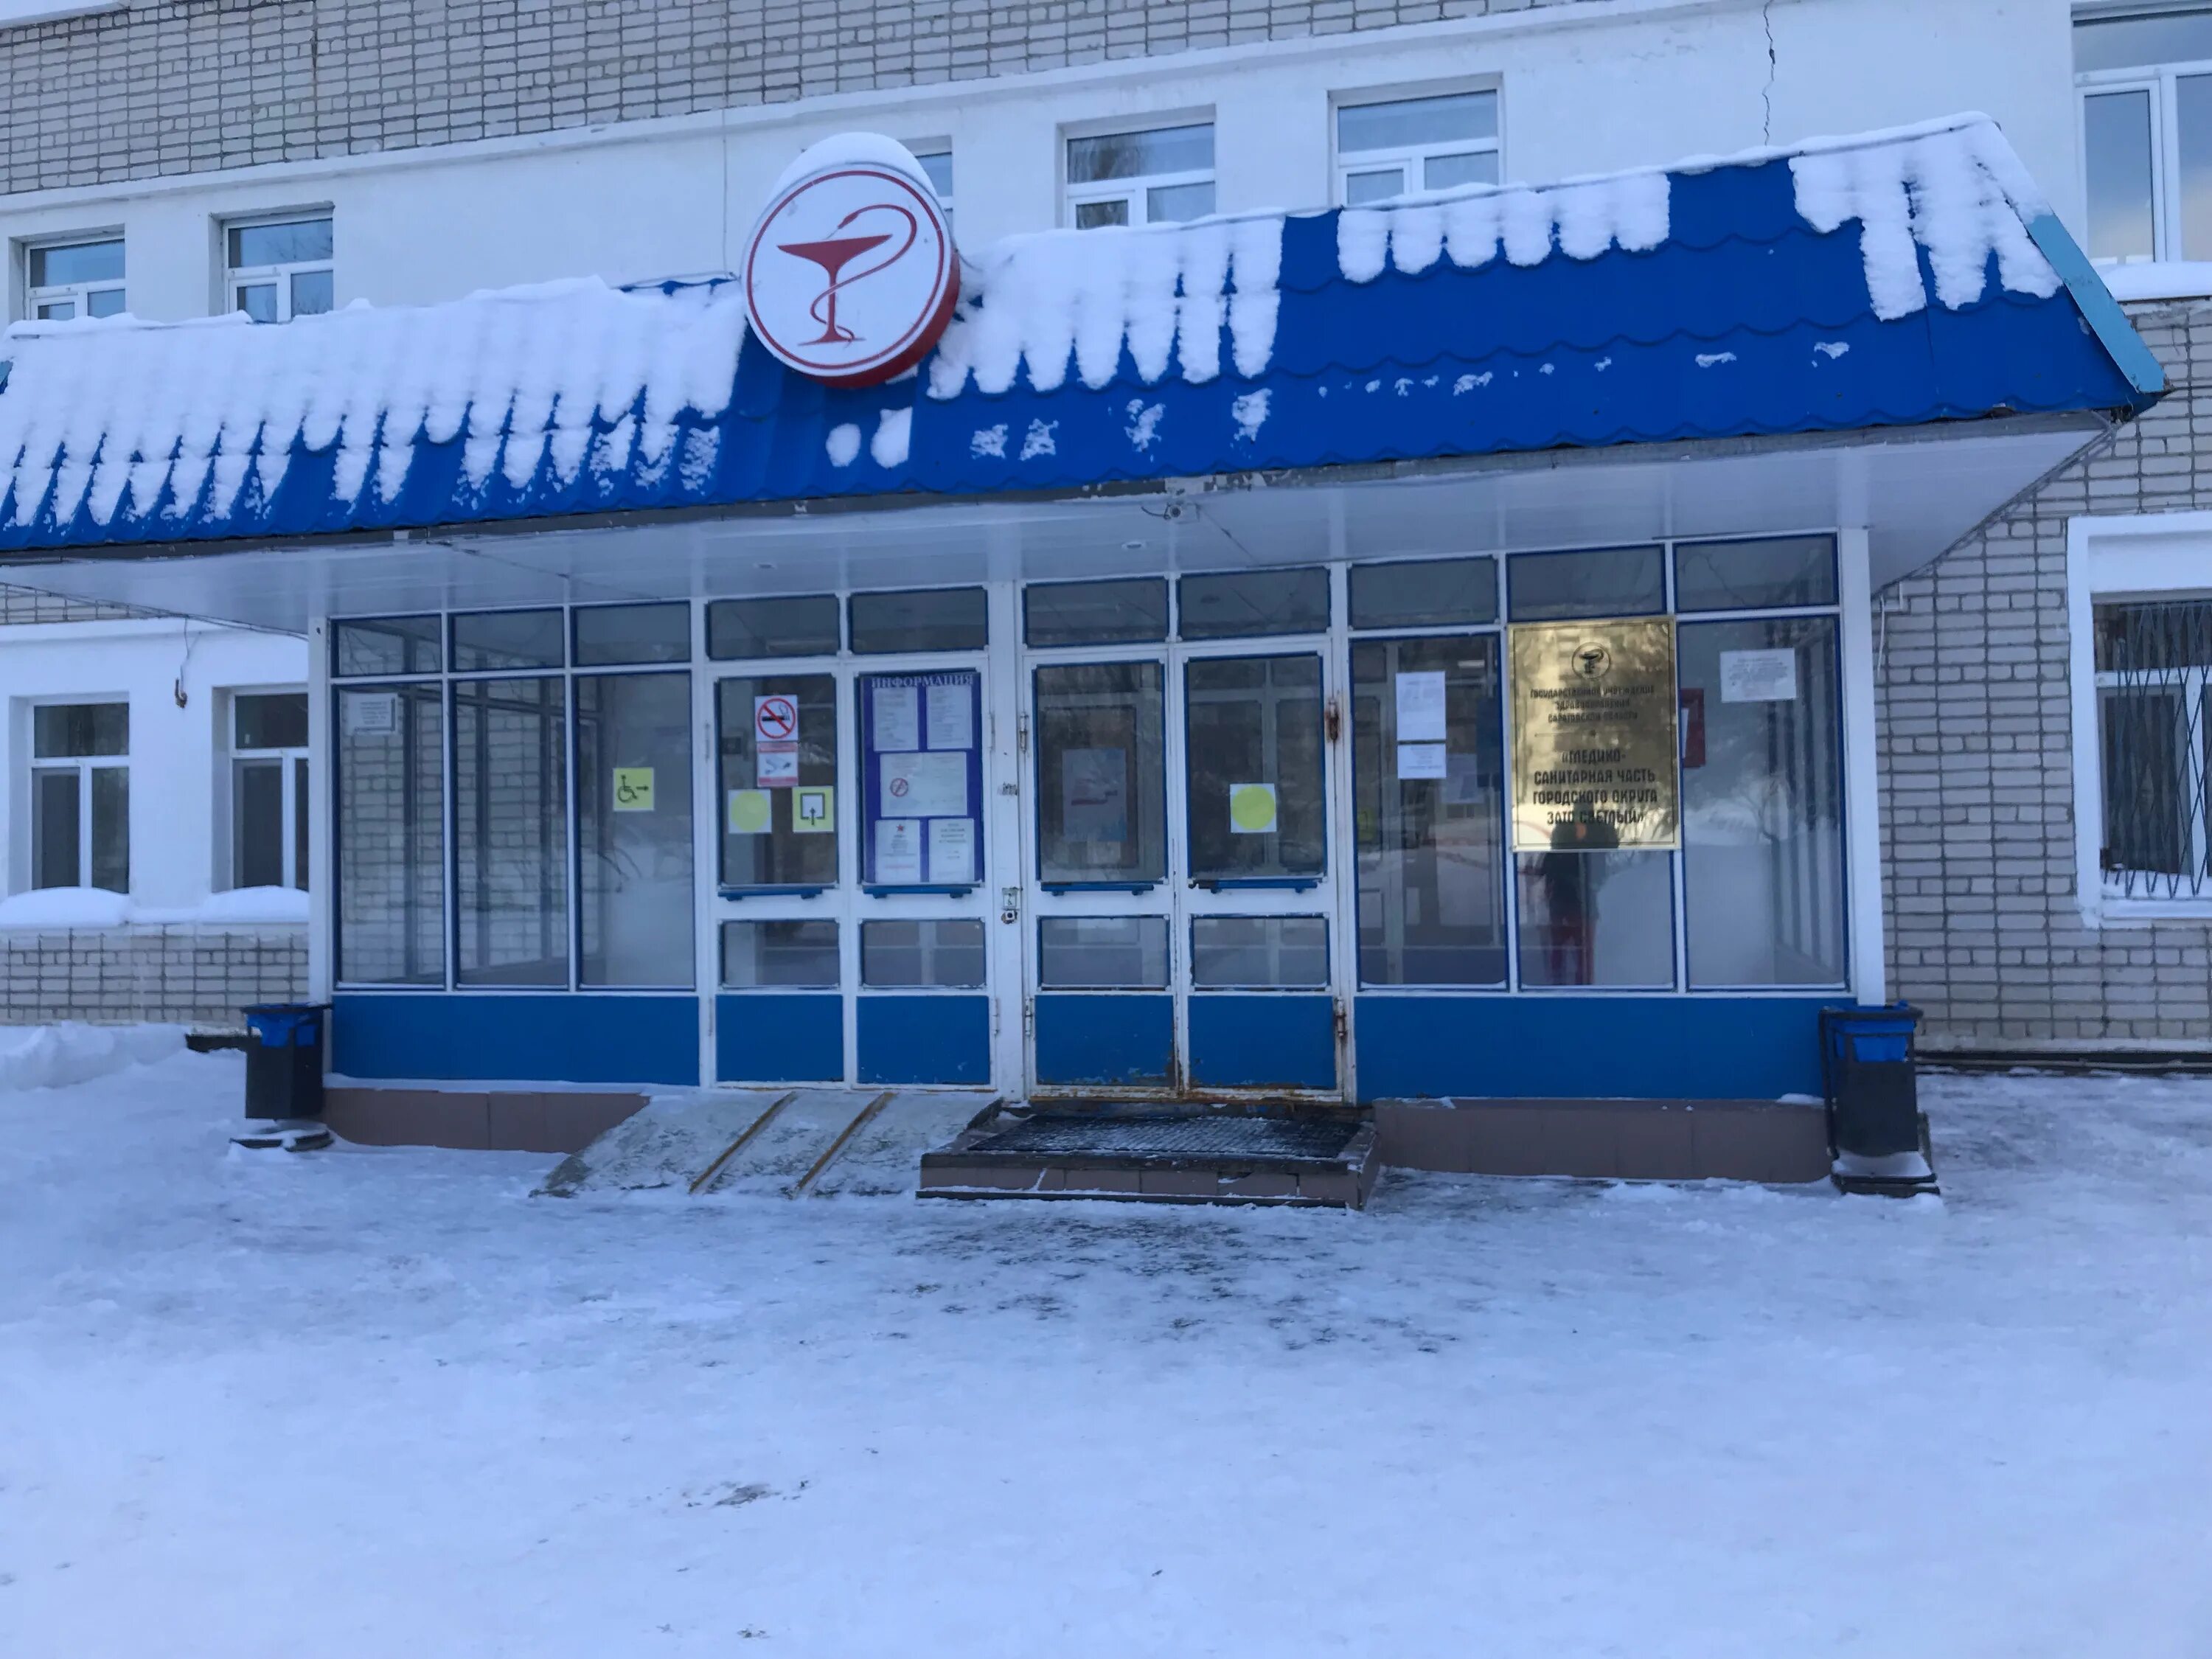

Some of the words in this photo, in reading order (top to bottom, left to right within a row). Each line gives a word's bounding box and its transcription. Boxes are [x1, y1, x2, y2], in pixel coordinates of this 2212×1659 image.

[872, 674, 973, 688] ИНФОРМАЦИЯ
[1534, 770, 1613, 785] САНИТАРНАЯ
[1617, 768, 1655, 783] ЧАСТЬ
[1533, 790, 1607, 806] ГОРОДСКОГО
[1613, 789, 1658, 803] ОКРУГА
[1547, 811, 1573, 825] ЗАТО
